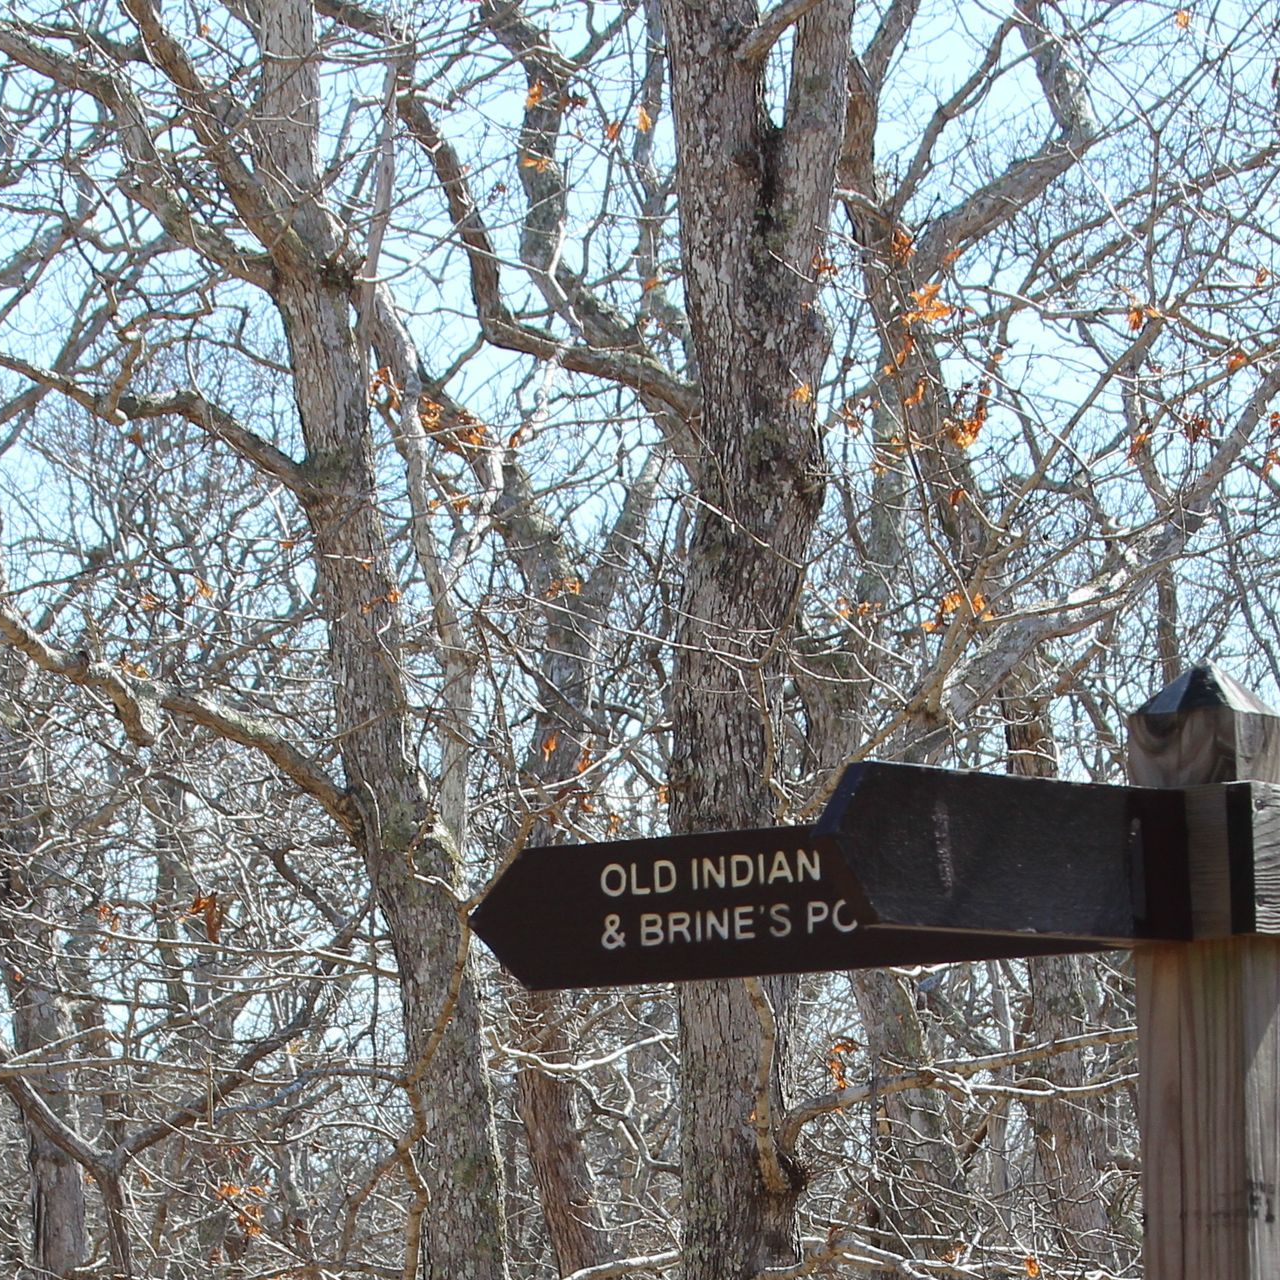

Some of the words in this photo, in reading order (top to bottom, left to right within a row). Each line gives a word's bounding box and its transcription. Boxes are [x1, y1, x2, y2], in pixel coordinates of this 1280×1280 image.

[600, 859, 677, 898] OLD
[691, 849, 821, 891] INDIAN
[601, 913, 626, 950] &
[640, 902, 792, 947] BRINE'S
